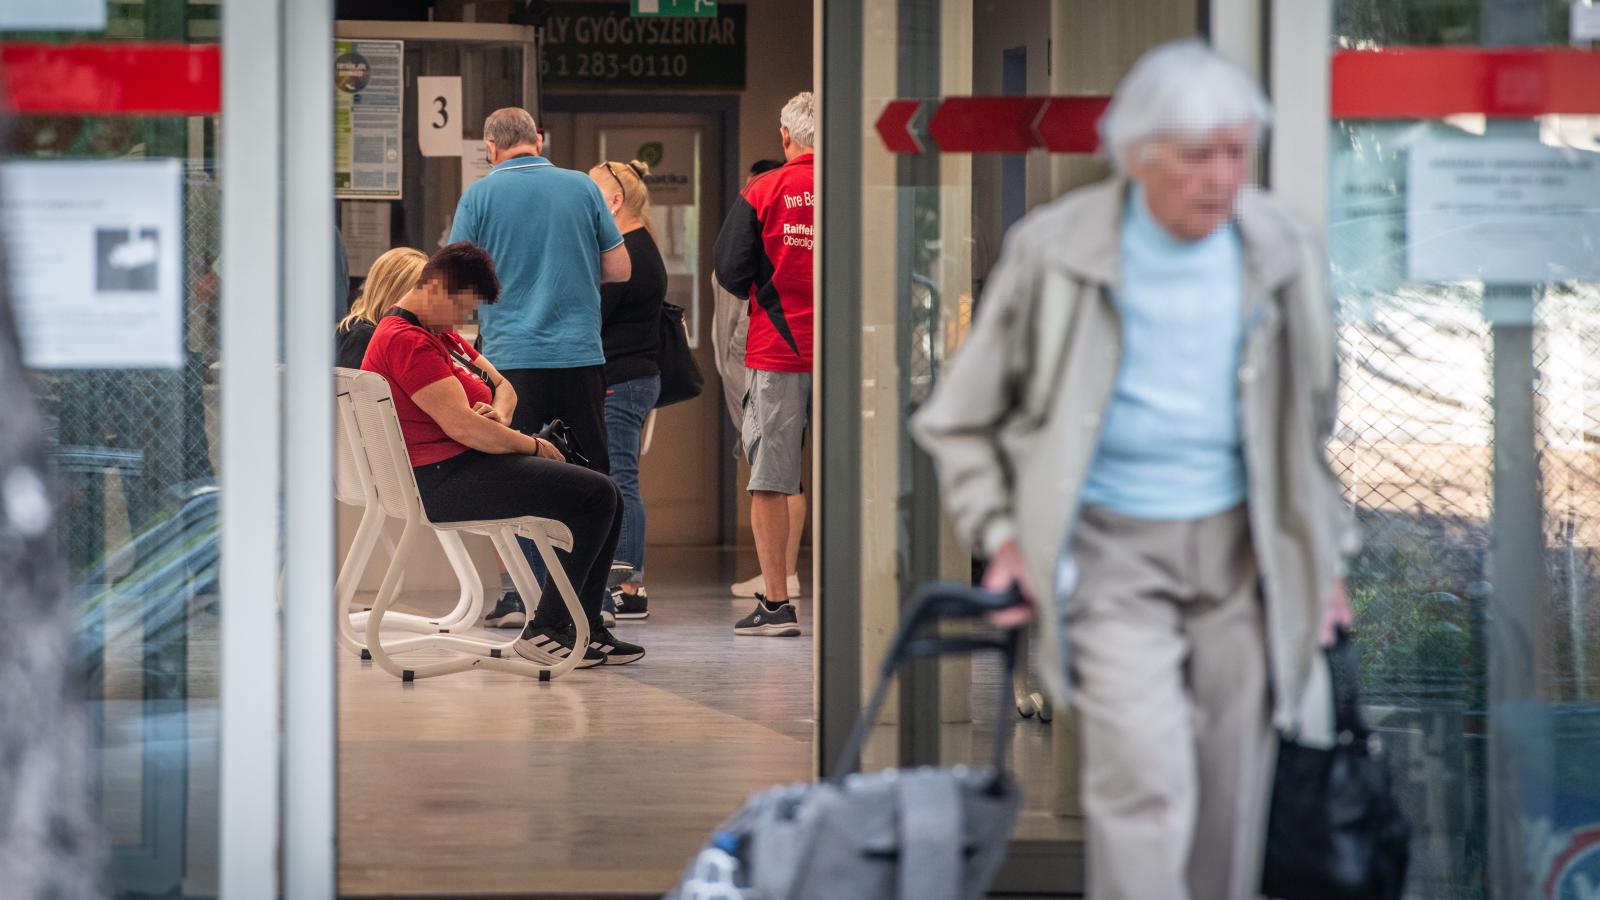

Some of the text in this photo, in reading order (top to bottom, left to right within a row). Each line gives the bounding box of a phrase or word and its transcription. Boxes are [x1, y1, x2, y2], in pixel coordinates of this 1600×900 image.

[544, 16, 571, 44] LY
[558, 53, 570, 75] 1
[576, 51, 689, 78] 283-0110
[432, 95, 449, 129] 3
[783, 194, 803, 209] Ihre
[783, 223, 815, 236] Raiffei
